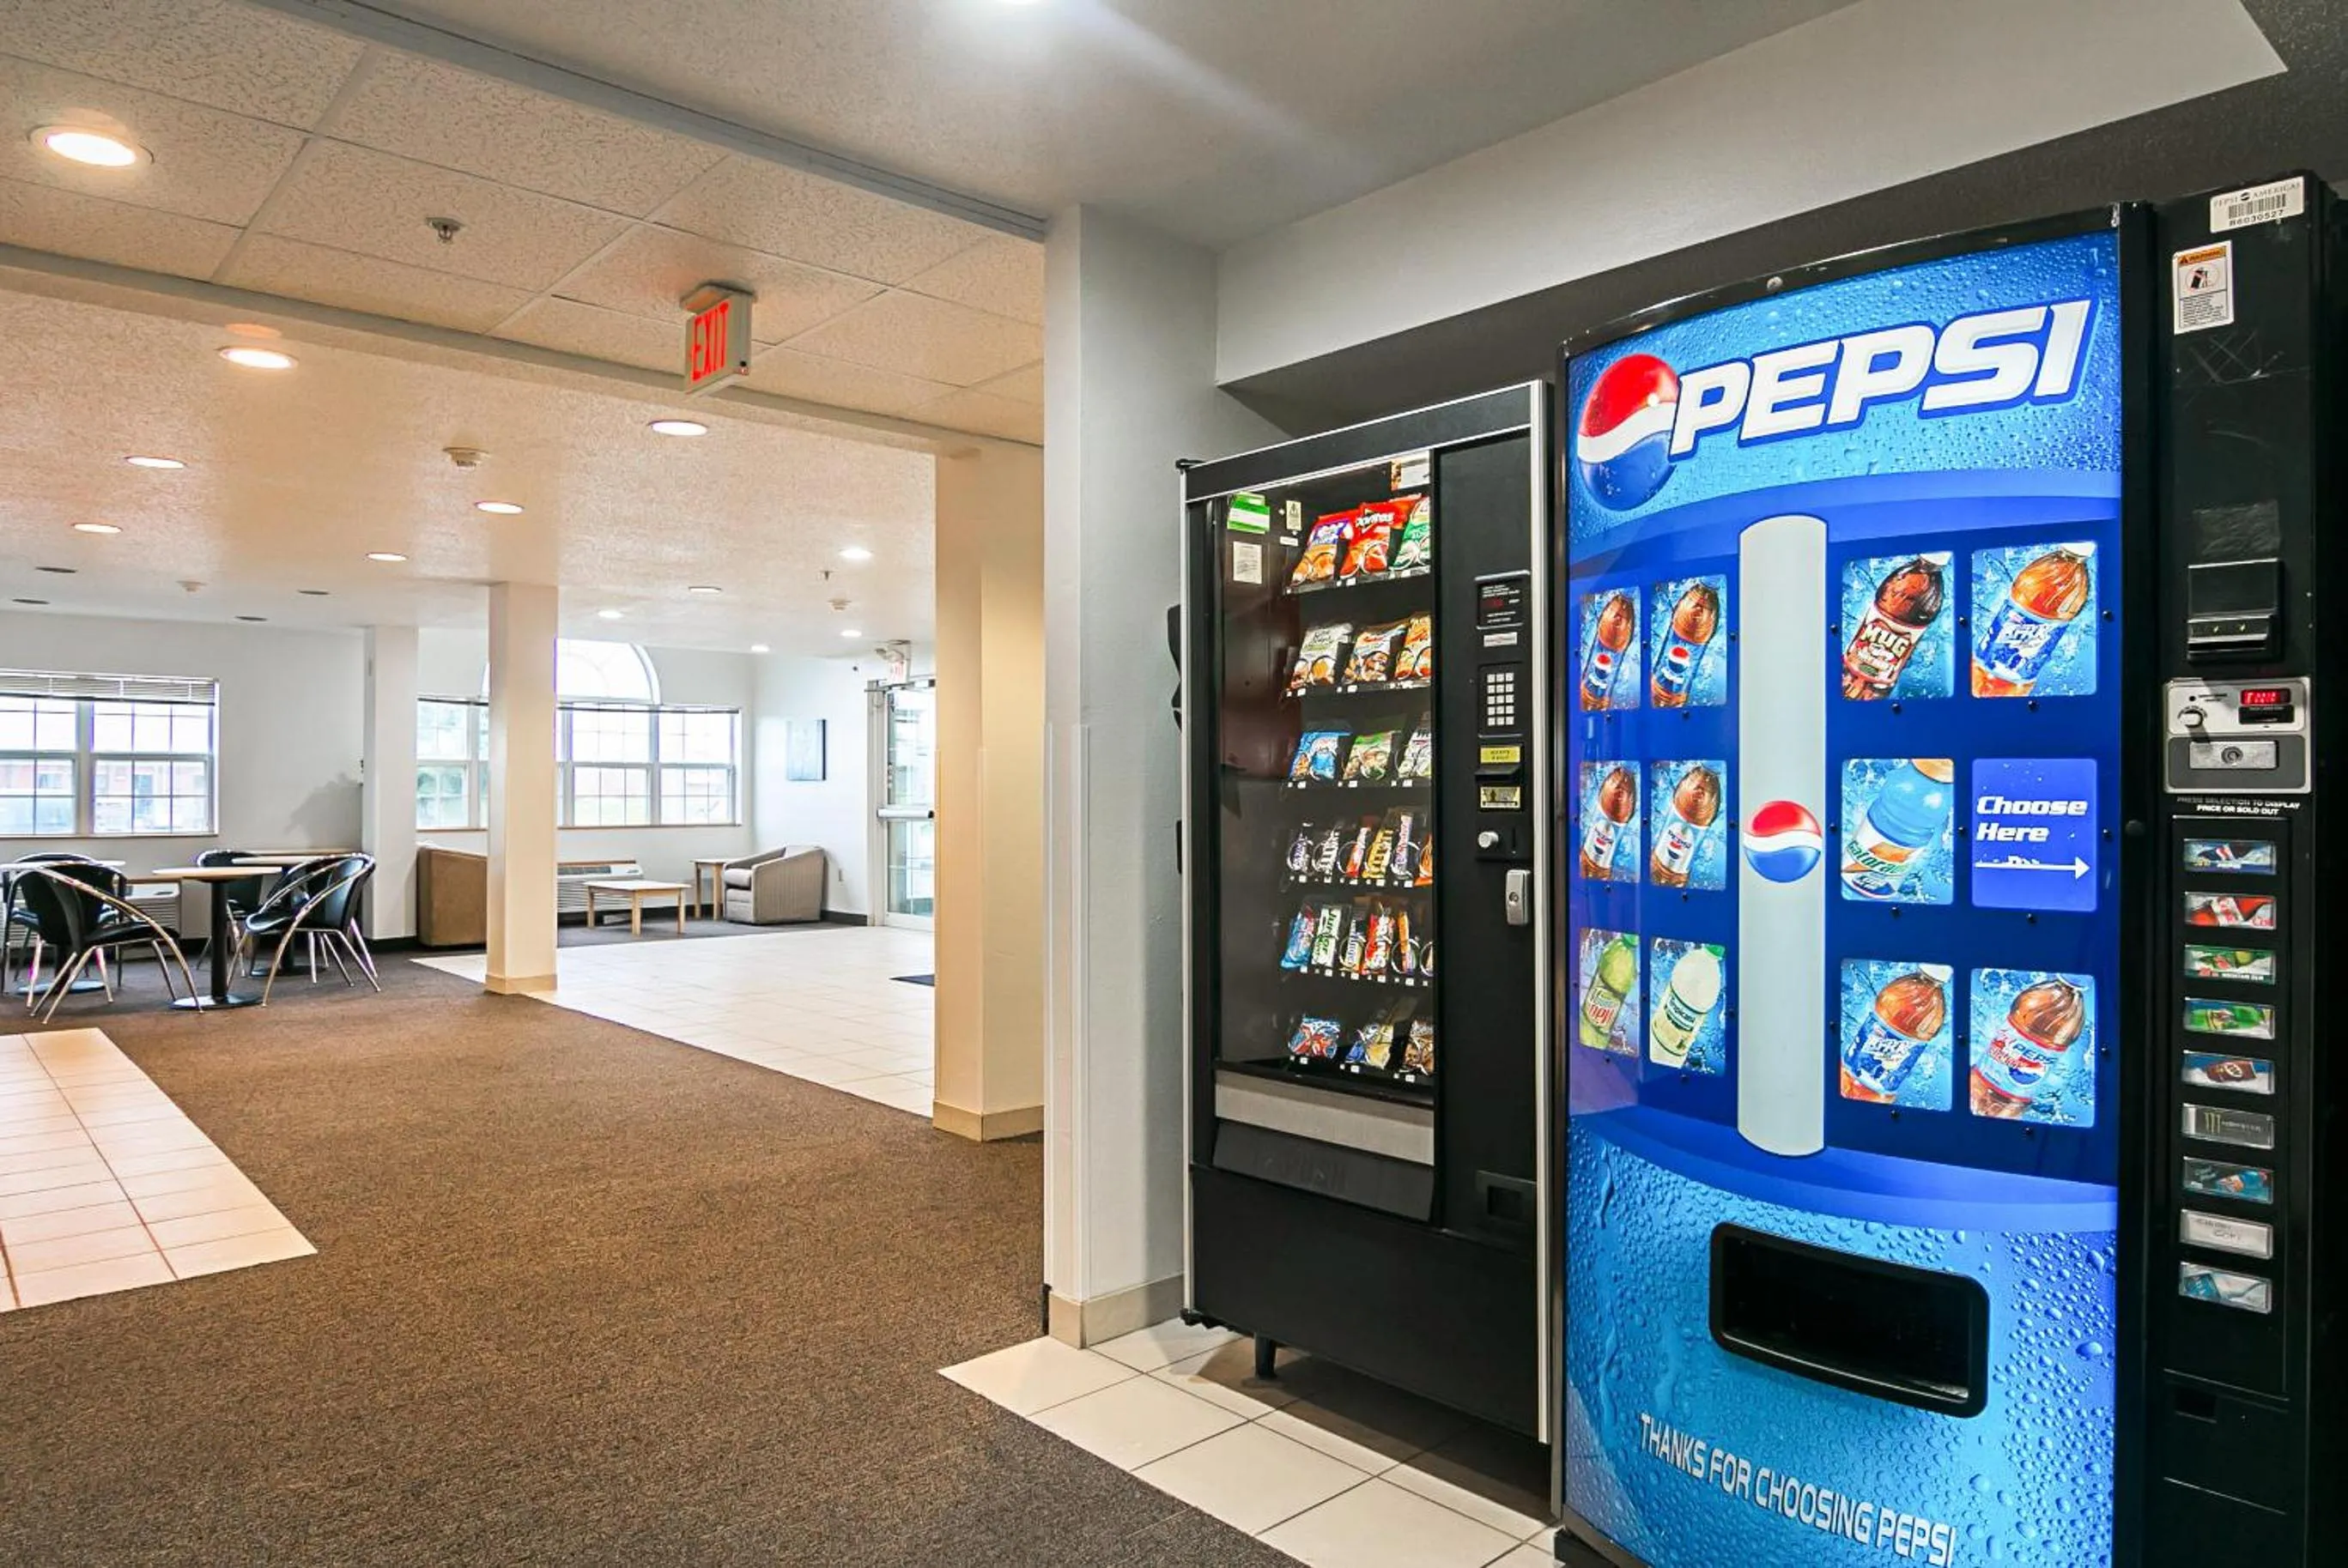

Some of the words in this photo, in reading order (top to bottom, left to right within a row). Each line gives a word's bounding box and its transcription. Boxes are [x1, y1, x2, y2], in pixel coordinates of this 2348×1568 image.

[690, 300, 730, 381] EXIT
[1668, 299, 2091, 456] PEPSI
[1860, 623, 1910, 659] MUG
[1976, 795, 2089, 816] Choose
[2196, 804, 2222, 813] PRICE
[2236, 806, 2260, 814] SOLD
[1976, 821, 2050, 843] Here
[1639, 1414, 1707, 1480] THANKS
[1708, 1448, 1752, 1501] FOR
[1755, 1467, 1875, 1546] CHOOSING
[1876, 1506, 1957, 1568] PEPSI
